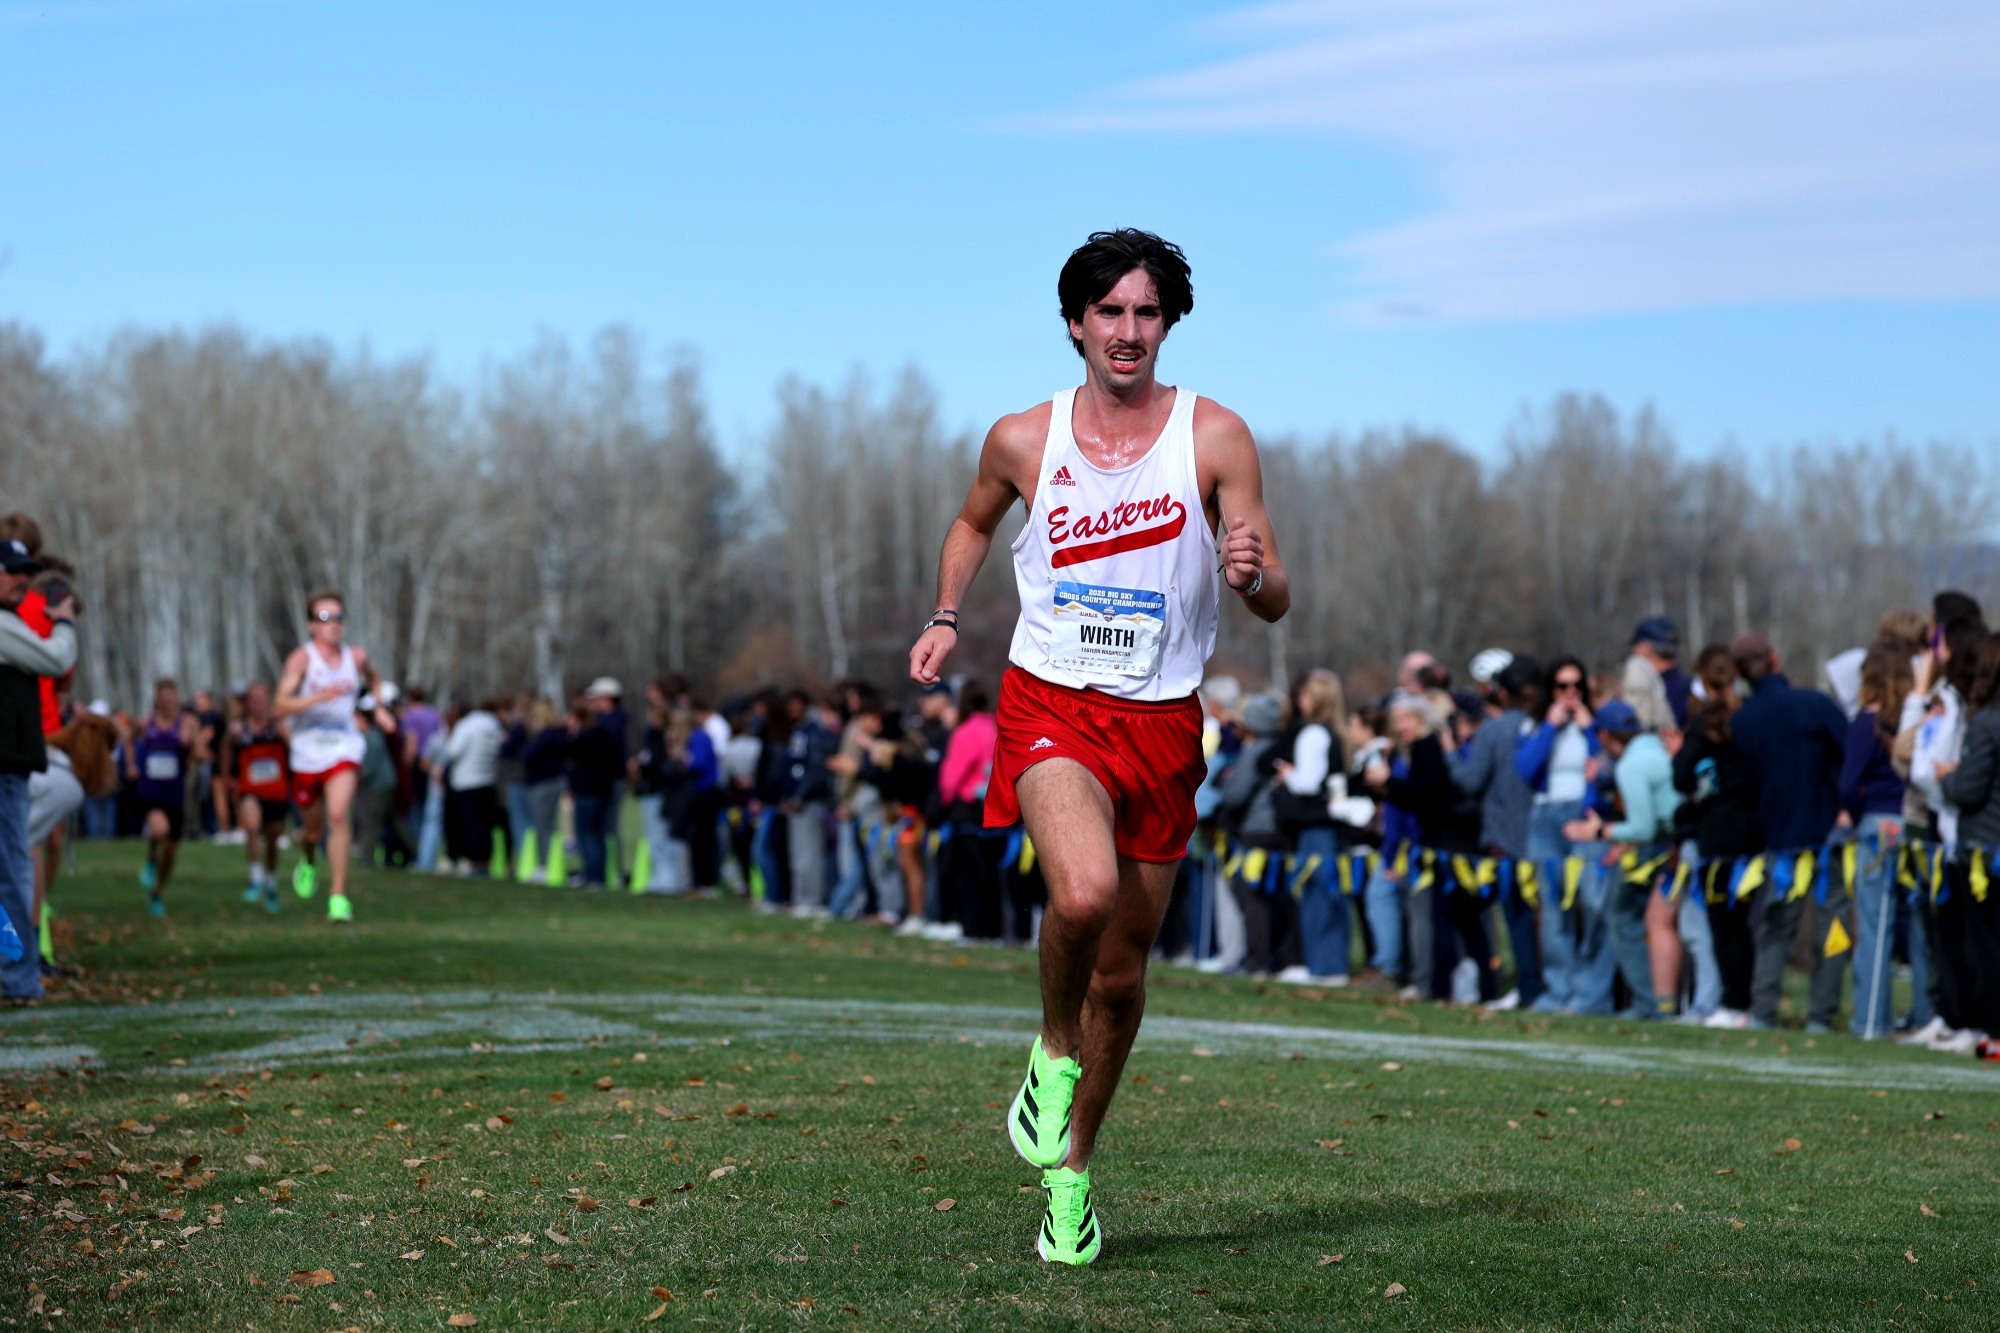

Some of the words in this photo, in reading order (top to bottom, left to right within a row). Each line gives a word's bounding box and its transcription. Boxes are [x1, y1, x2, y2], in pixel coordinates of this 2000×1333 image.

[1047, 493, 1186, 545] Eastern
[1059, 591, 1080, 601] CROSS
[1081, 594, 1112, 605] COUNTRY
[1112, 599, 1163, 609] CHAMPIONSHIP
[1088, 589, 1106, 598] 2025
[1107, 591, 1119, 599] BIG
[1120, 592, 1134, 600] SKY
[1080, 624, 1135, 648] WIRTH
